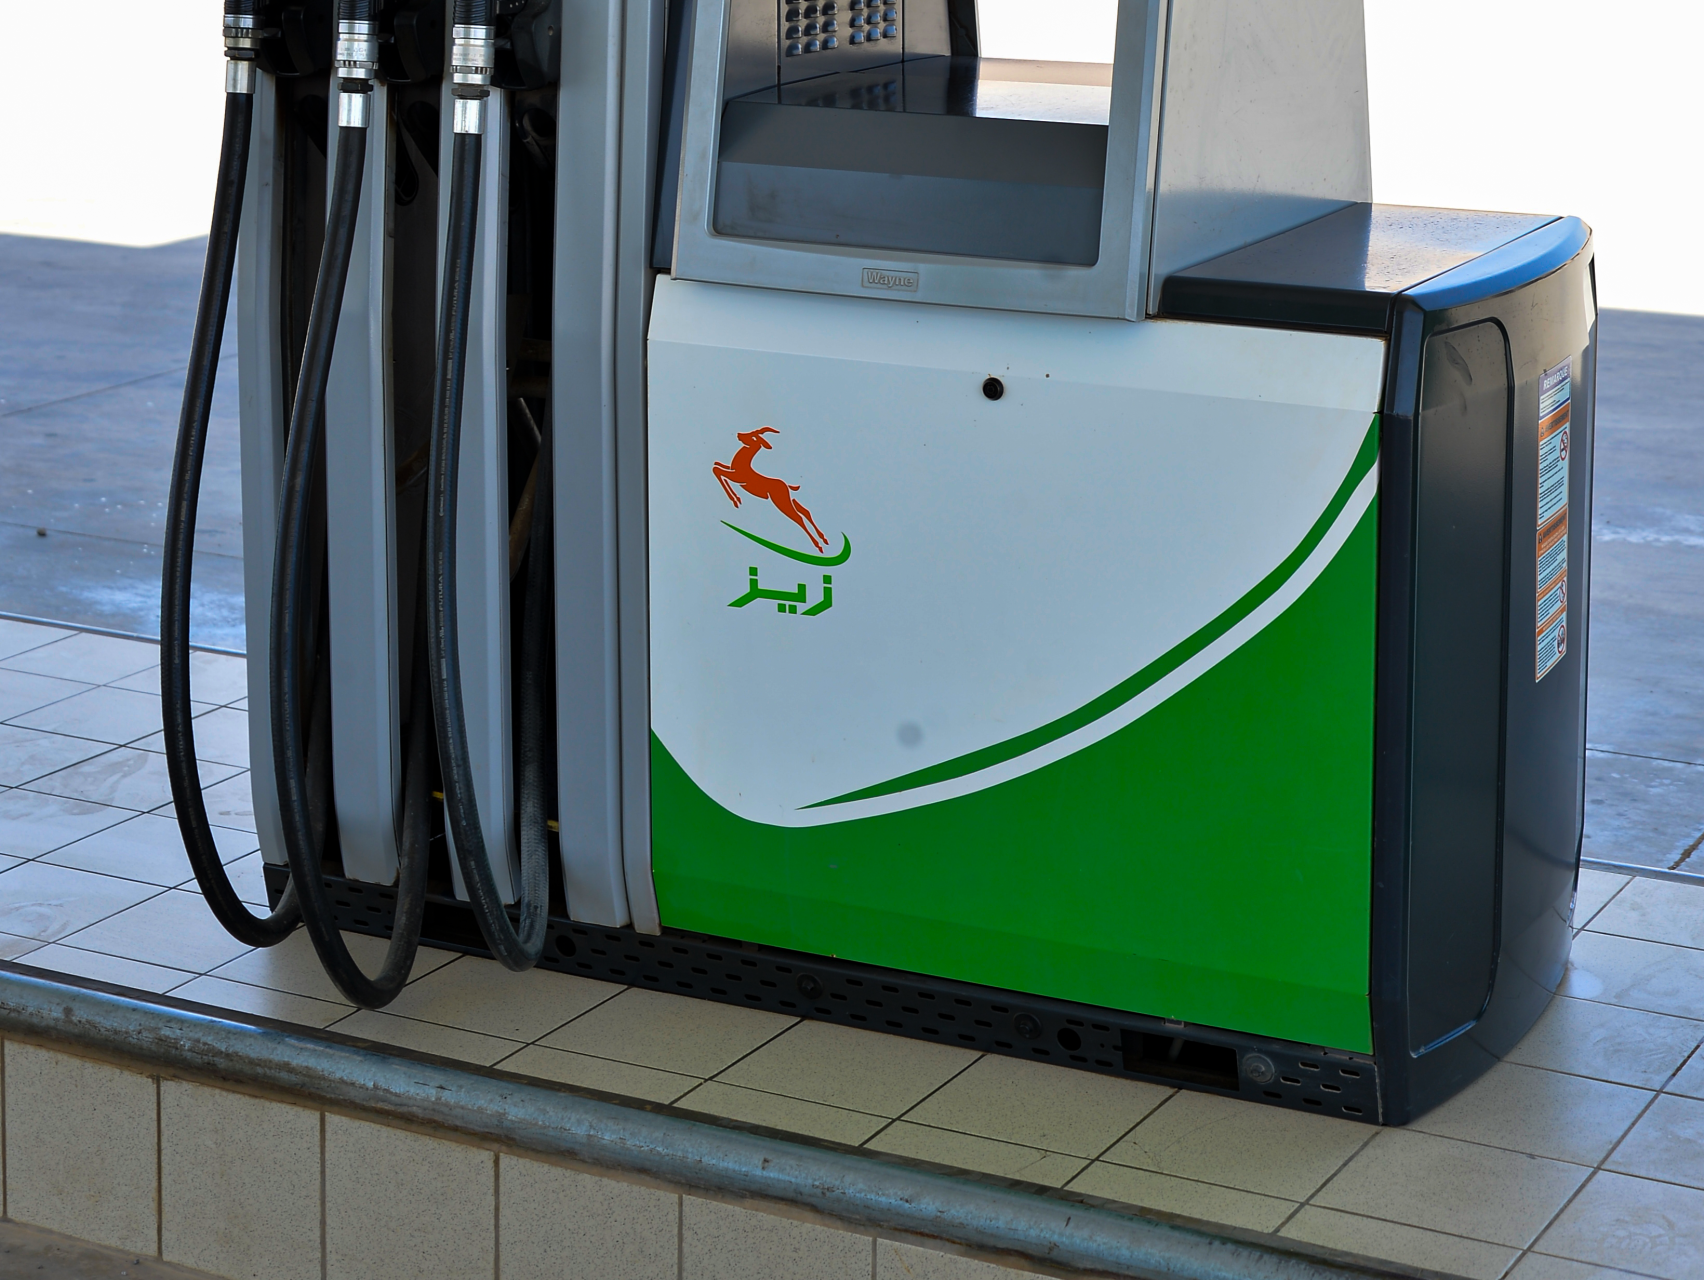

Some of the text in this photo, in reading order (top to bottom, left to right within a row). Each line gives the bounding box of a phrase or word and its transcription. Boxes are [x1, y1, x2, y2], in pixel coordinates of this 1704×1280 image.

[866, 270, 914, 288] Wayne
[1543, 365, 1568, 391] REMARQUE
[727, 566, 833, 617] زيز
